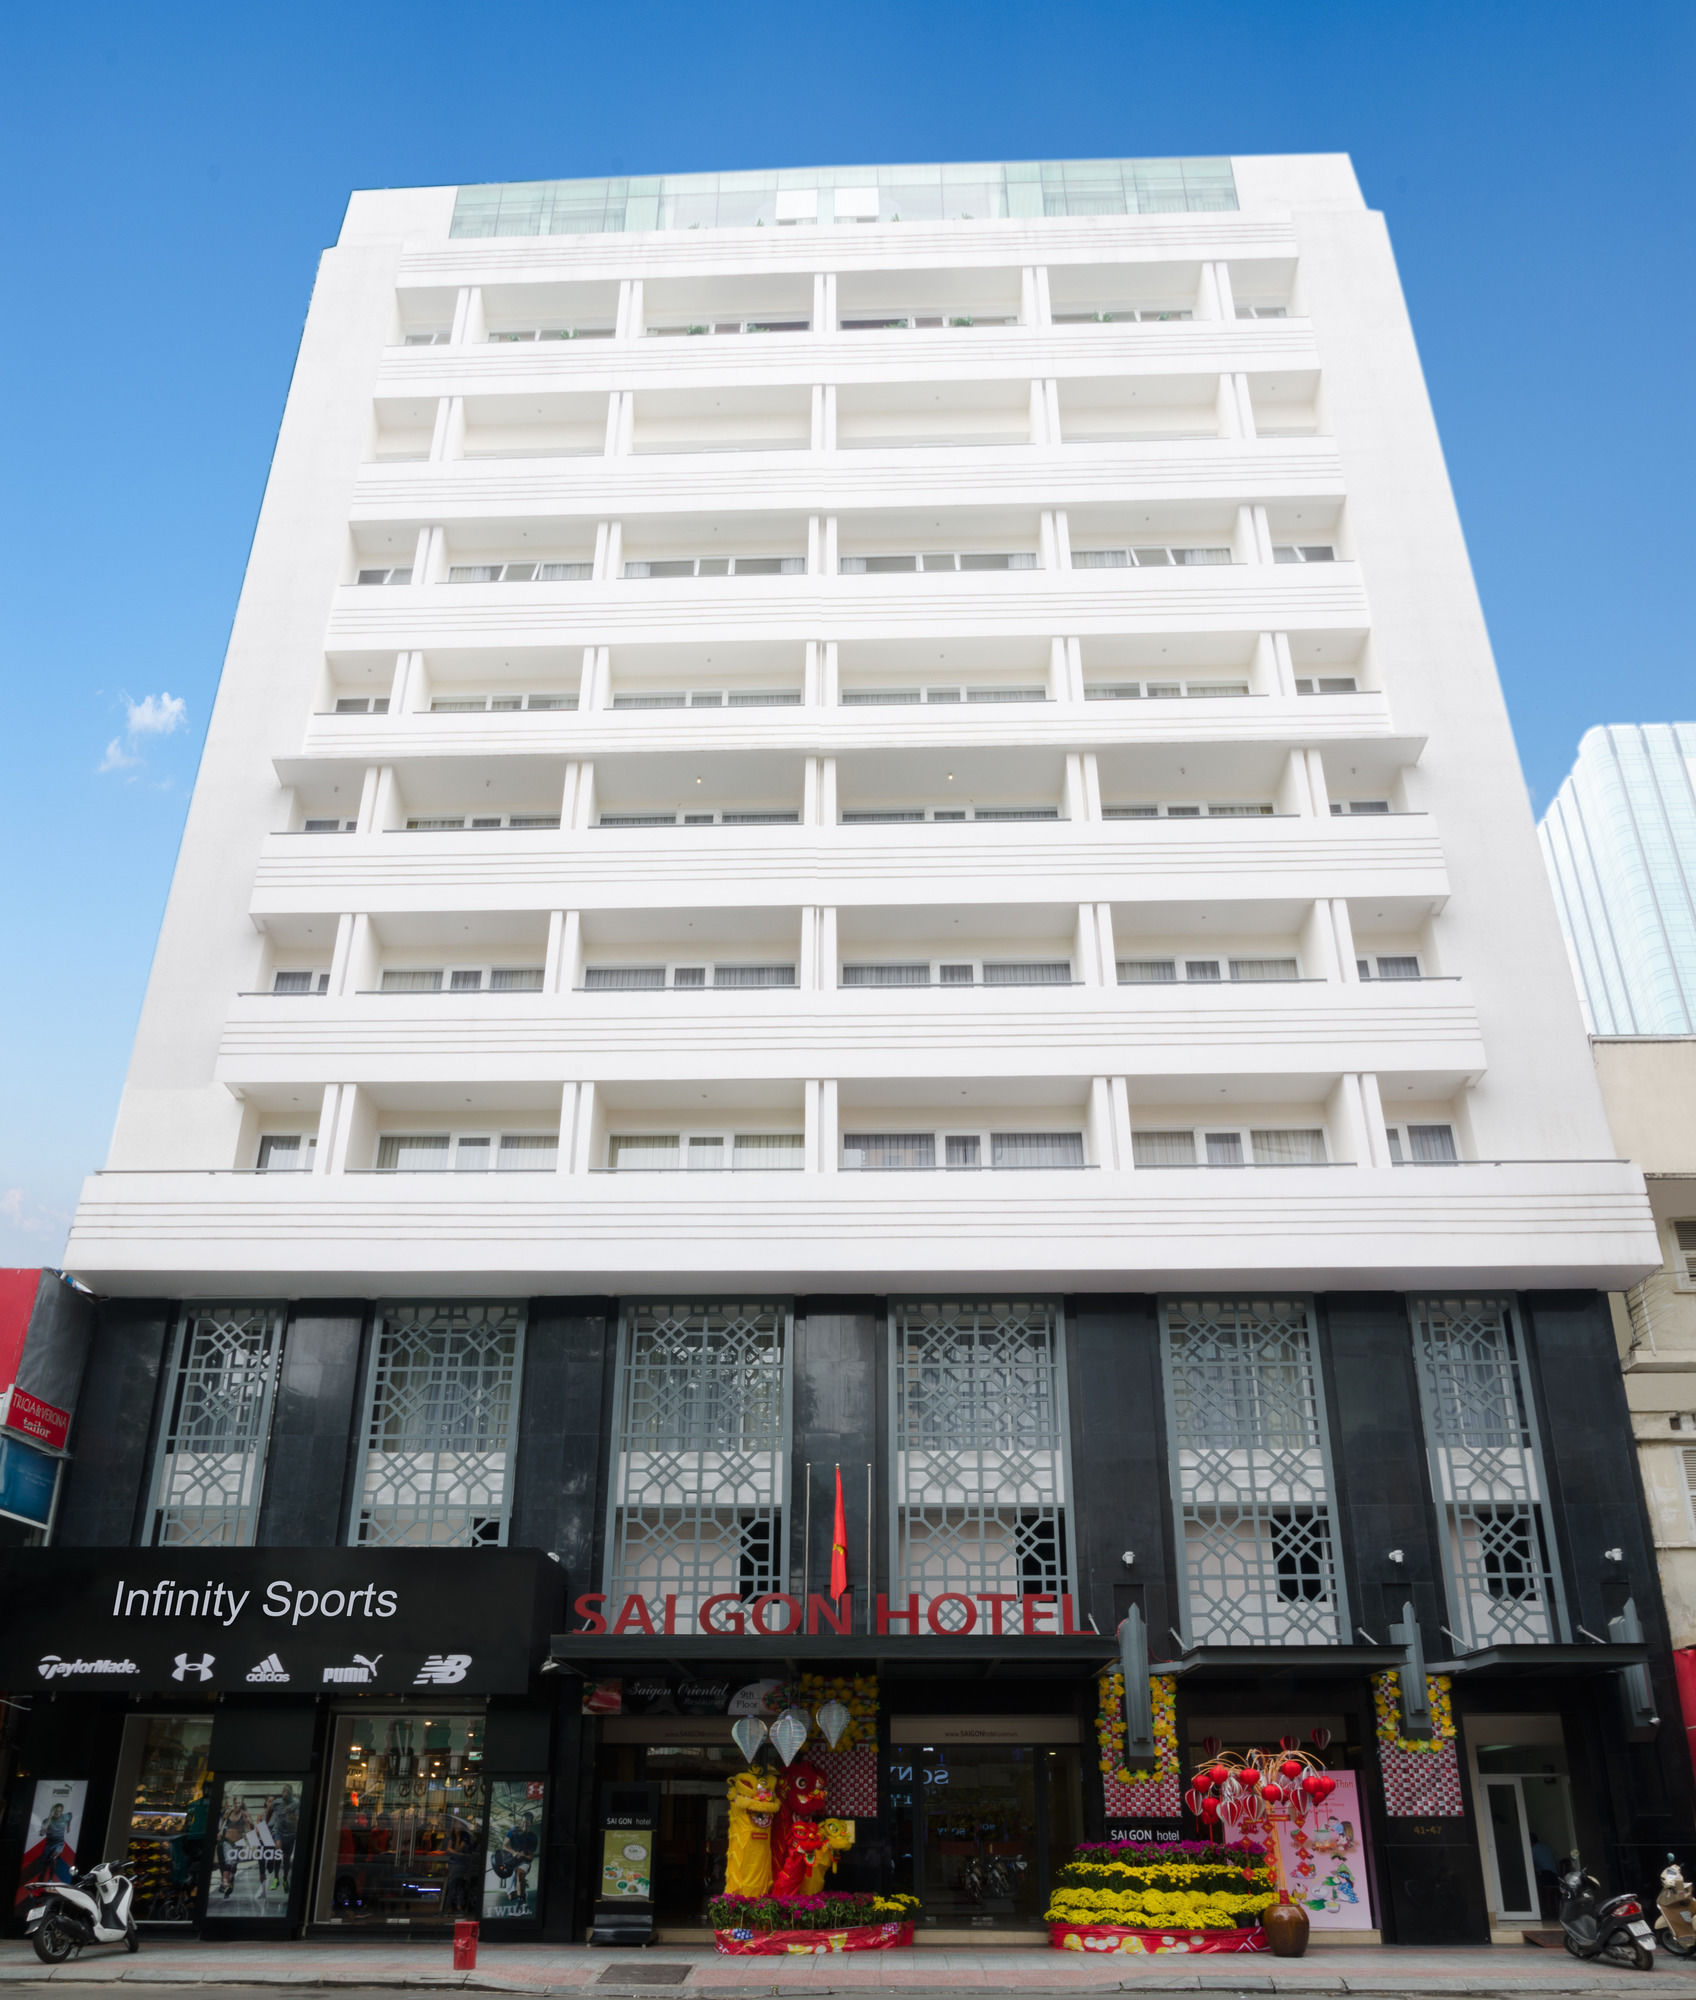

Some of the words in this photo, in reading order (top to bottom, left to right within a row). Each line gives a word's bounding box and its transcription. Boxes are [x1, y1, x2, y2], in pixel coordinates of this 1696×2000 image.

[23, 1417, 51, 1438] tailor
[113, 1581, 250, 1626] Infinity
[262, 1581, 398, 1626] Sports
[877, 1593, 1099, 1636] HOTEL
[38, 1655, 139, 1680] TaylorMade
[322, 1668, 370, 1683] PUMA
[246, 1671, 290, 1682] adidas
[628, 1682, 671, 1700] Saigon
[677, 1681, 729, 1697] Oriental
[736, 1700, 758, 1708] Floor
[1156, 1830, 1180, 1841] hotel
[227, 1846, 284, 1861] adidas
